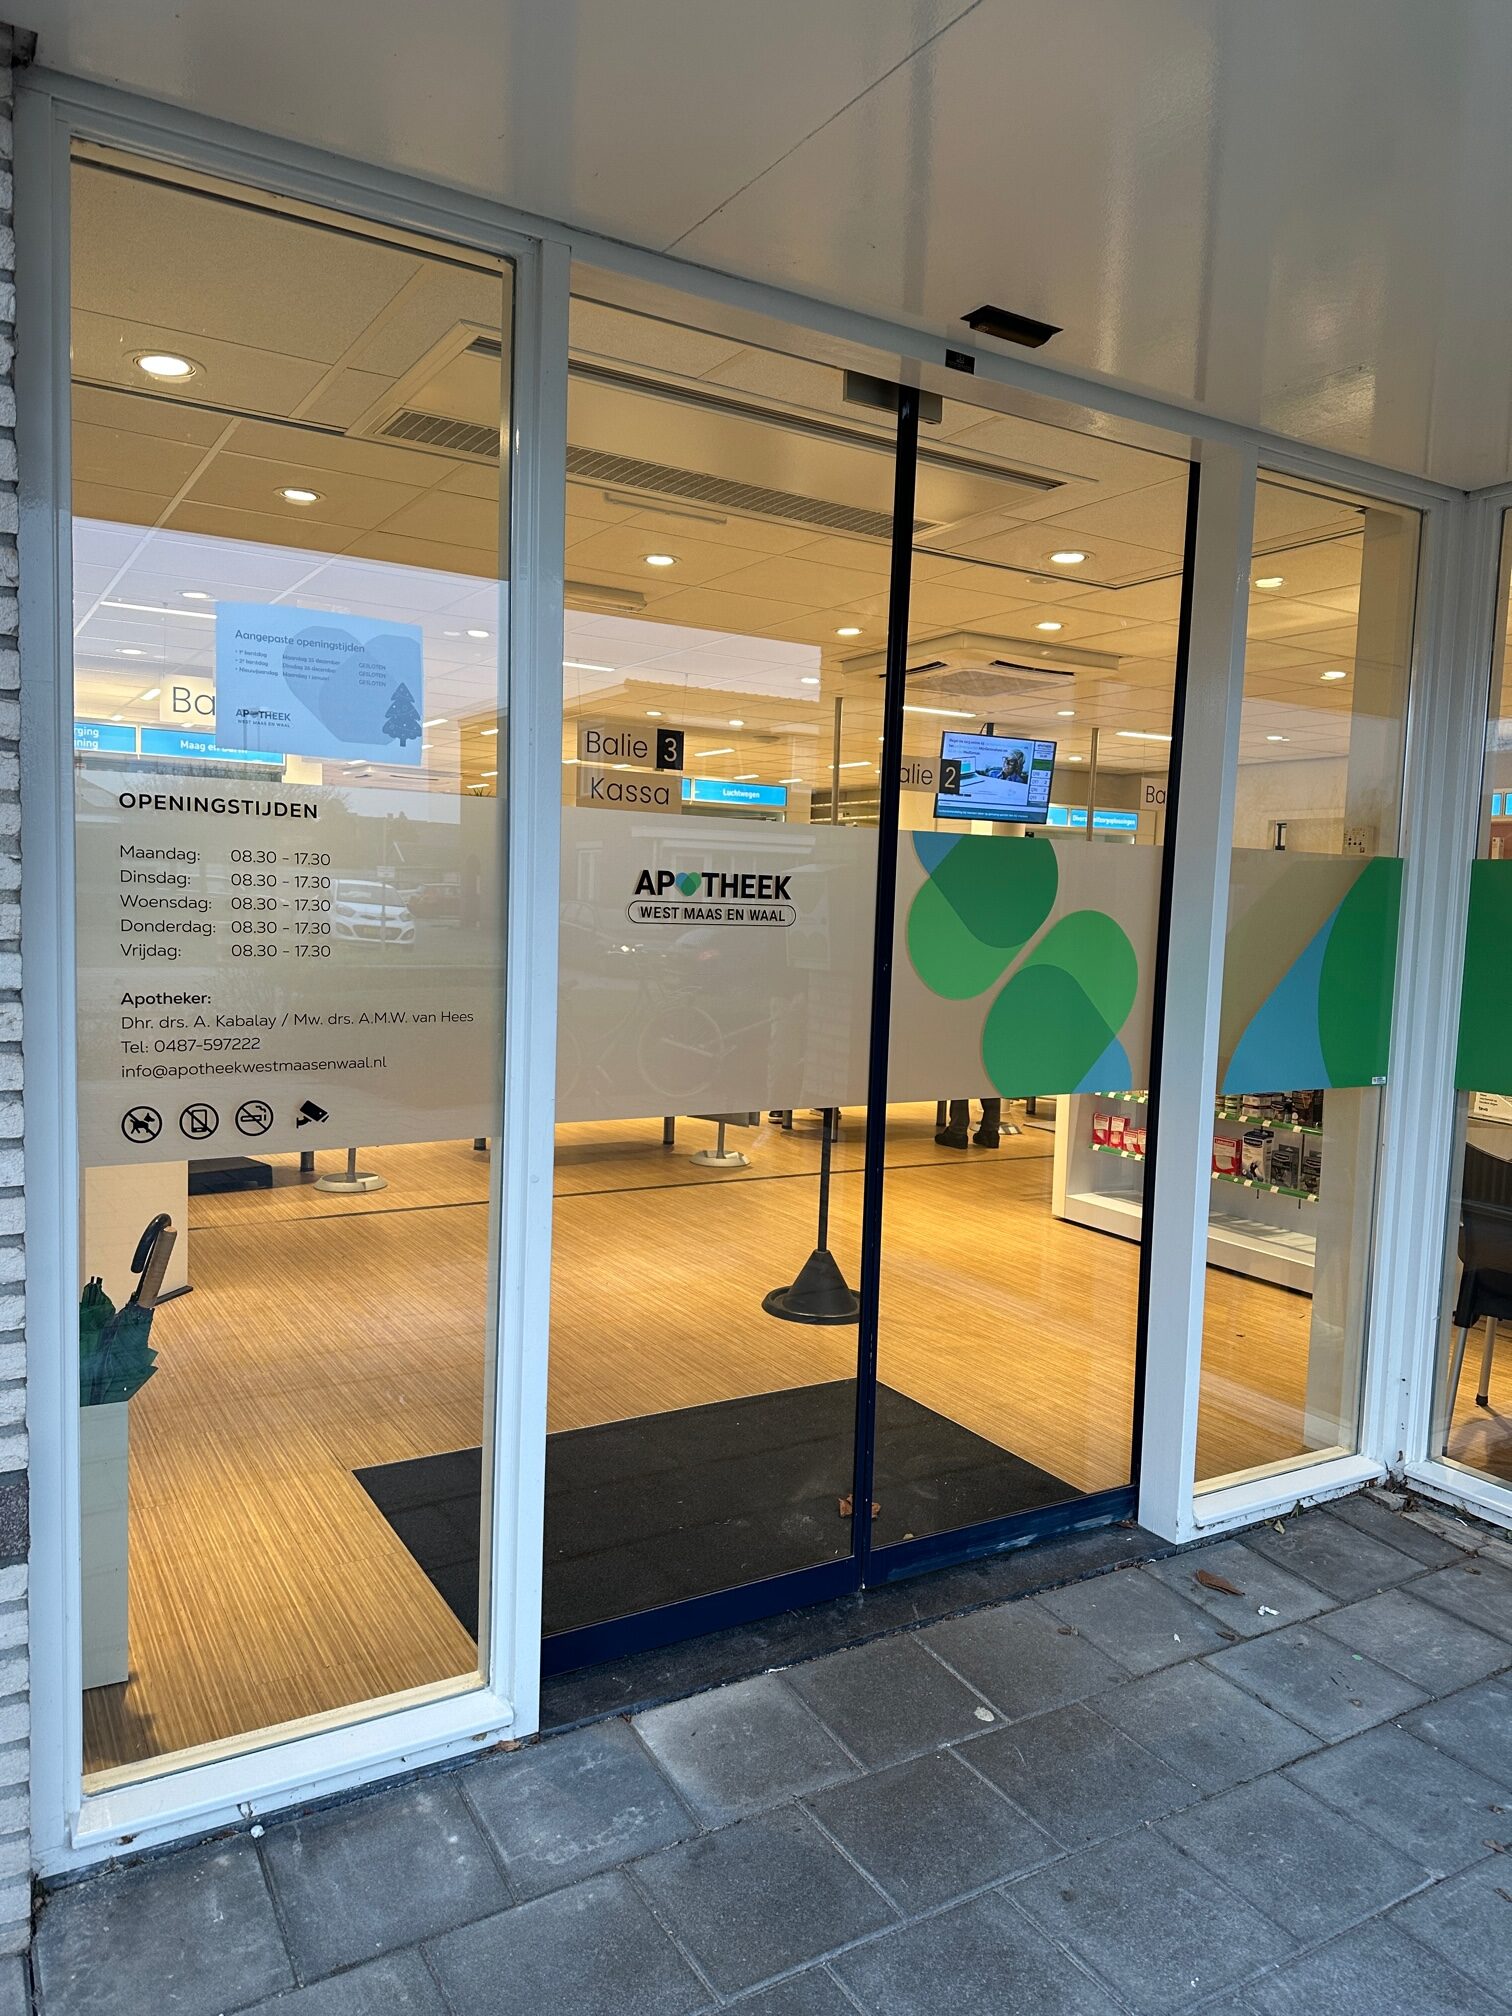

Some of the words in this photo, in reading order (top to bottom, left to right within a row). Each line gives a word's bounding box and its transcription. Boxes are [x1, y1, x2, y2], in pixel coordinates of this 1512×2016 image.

[235, 629, 295, 645] Aangepaste
[297, 638, 365, 653] openingstijden
[180, 740, 206, 753] Maag
[586, 730, 649, 759] Balie
[664, 738, 678, 762] 3
[944, 767, 956, 789] 2
[591, 776, 670, 805] Kassa
[723, 788, 760, 800] Luchtwegen
[119, 793, 319, 819] OPENINGSTIJDEN
[120, 846, 201, 864] Maandag:
[231, 850, 278, 864] 08.30
[295, 852, 331, 866] 17.30
[120, 870, 191, 888] Dinsdag:
[231, 874, 278, 888] 08.30
[295, 875, 331, 889] 17.30
[120, 895, 212, 913] Woensdag:
[231, 897, 278, 911] 08.30
[295, 899, 331, 913] 17.30
[640, 906, 680, 920] WEST
[684, 908, 723, 921] MAAS
[727, 909, 744, 921] EN
[750, 909, 786, 922] WAAL
[121, 919, 216, 937] Donderdag:
[231, 921, 278, 935] 08.30
[295, 922, 331, 936] 17.30
[121, 944, 182, 961] Vrijdag:
[231, 944, 278, 958] 08.30
[295, 945, 331, 958] 17.30
[121, 991, 212, 1008] Apotheker:
[122, 1016, 154, 1030] Dhr.
[159, 1016, 189, 1030] drs.
[194, 1015, 211, 1029] A.
[216, 1013, 277, 1032] Kabalay
[281, 1013, 289, 1030] /
[294, 1013, 324, 1027] Mw.
[328, 1012, 355, 1026] drs.
[359, 1012, 408, 1025] A.M.W.
[412, 1014, 437, 1024] van
[441, 1010, 474, 1024] Hees
[121, 1041, 149, 1055] Tel:
[154, 1038, 261, 1054] 0487-597222
[121, 1057, 387, 1080] info@apotheekwestmaasenwaal.nl
